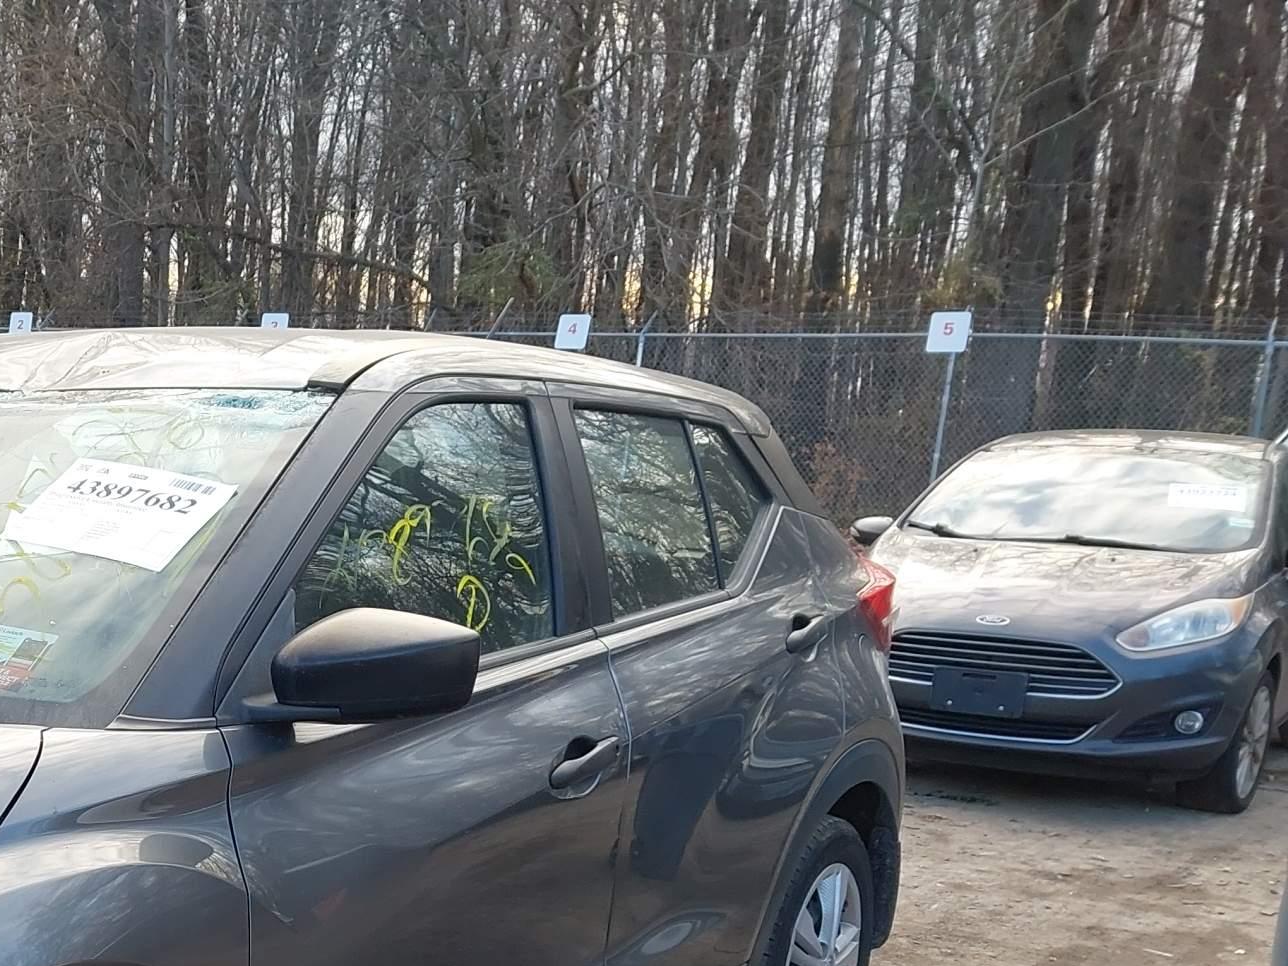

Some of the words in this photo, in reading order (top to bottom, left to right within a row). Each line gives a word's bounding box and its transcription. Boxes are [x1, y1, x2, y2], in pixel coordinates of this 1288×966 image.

[16, 319, 24, 330] 2
[568, 322, 577, 335] 4
[943, 322, 955, 336] 5
[66, 477, 198, 515] 43897682
